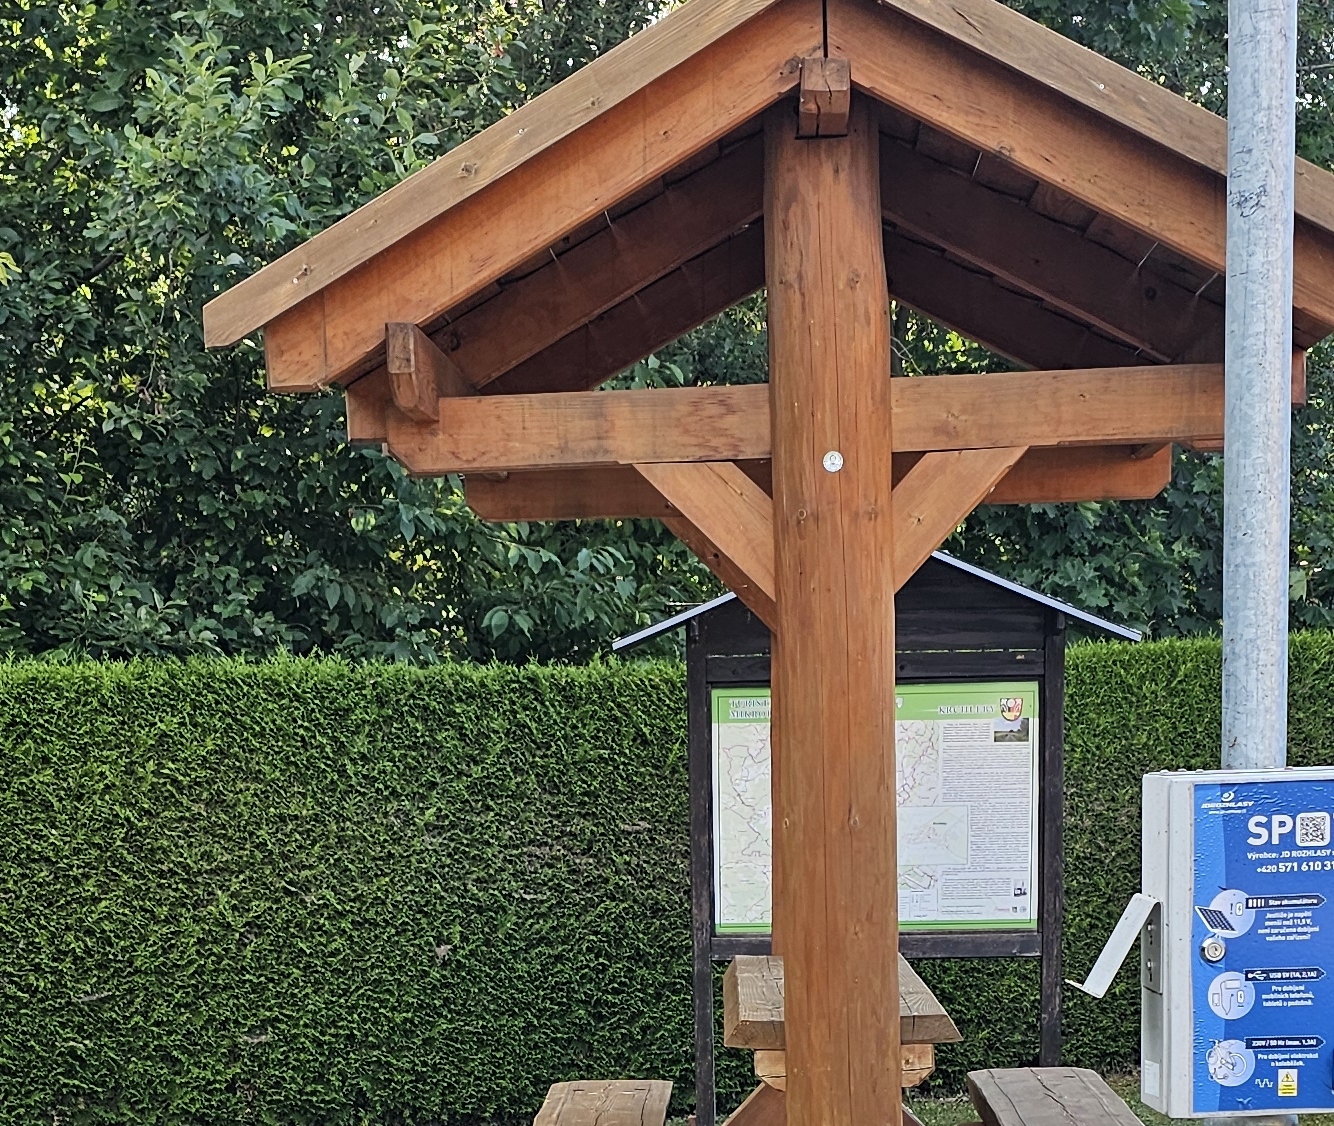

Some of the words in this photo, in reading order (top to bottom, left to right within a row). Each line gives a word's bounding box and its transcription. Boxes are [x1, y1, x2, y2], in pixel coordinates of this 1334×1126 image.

[1291, 850, 1331, 858] ROZHLASY
[1278, 861, 1298, 872] 571
[1300, 861, 1322, 871] 610
